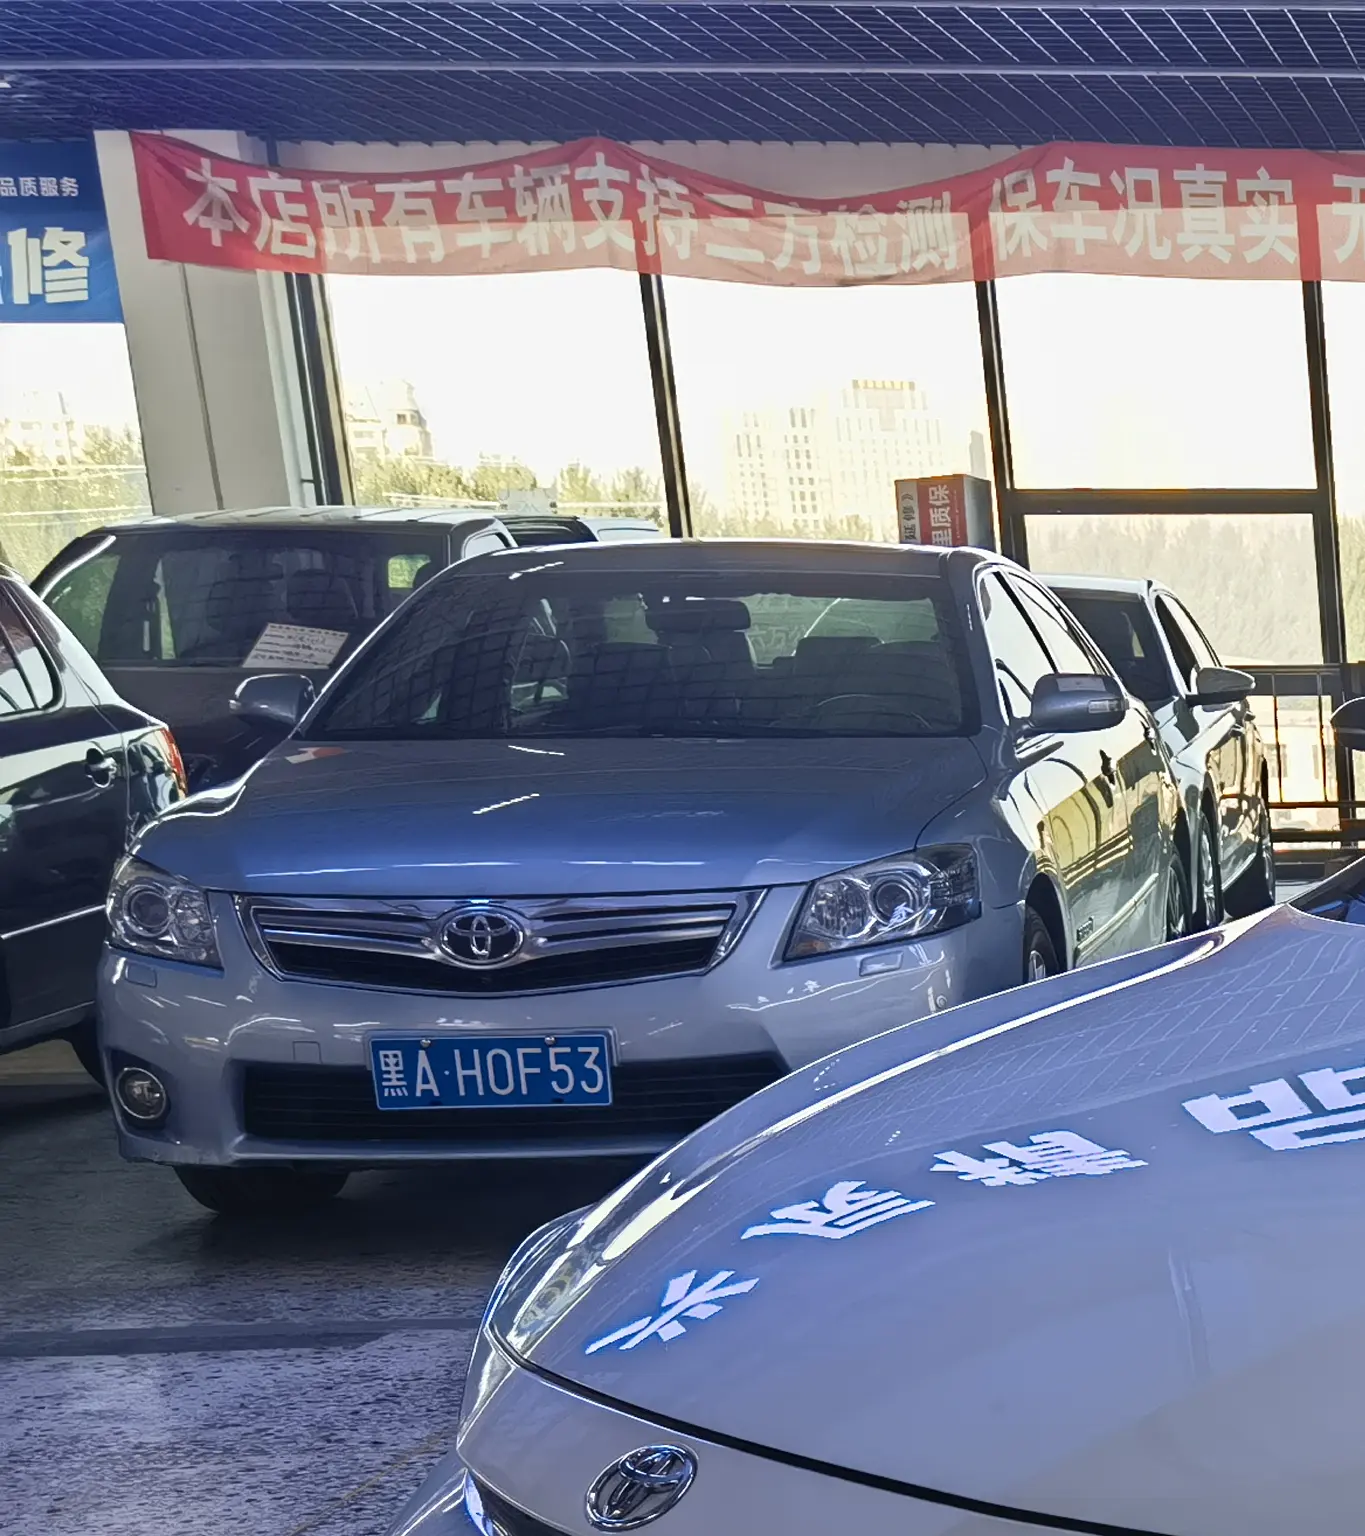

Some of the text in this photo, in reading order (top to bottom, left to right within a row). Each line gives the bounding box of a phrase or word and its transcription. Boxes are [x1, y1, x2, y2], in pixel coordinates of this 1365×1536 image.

[0, 176, 79, 197] 品质服务
[182, 152, 964, 277] 本店所有车辆支持三方检测
[989, 156, 1299, 264] 保车况真实
[0, 226, 89, 304] 修
